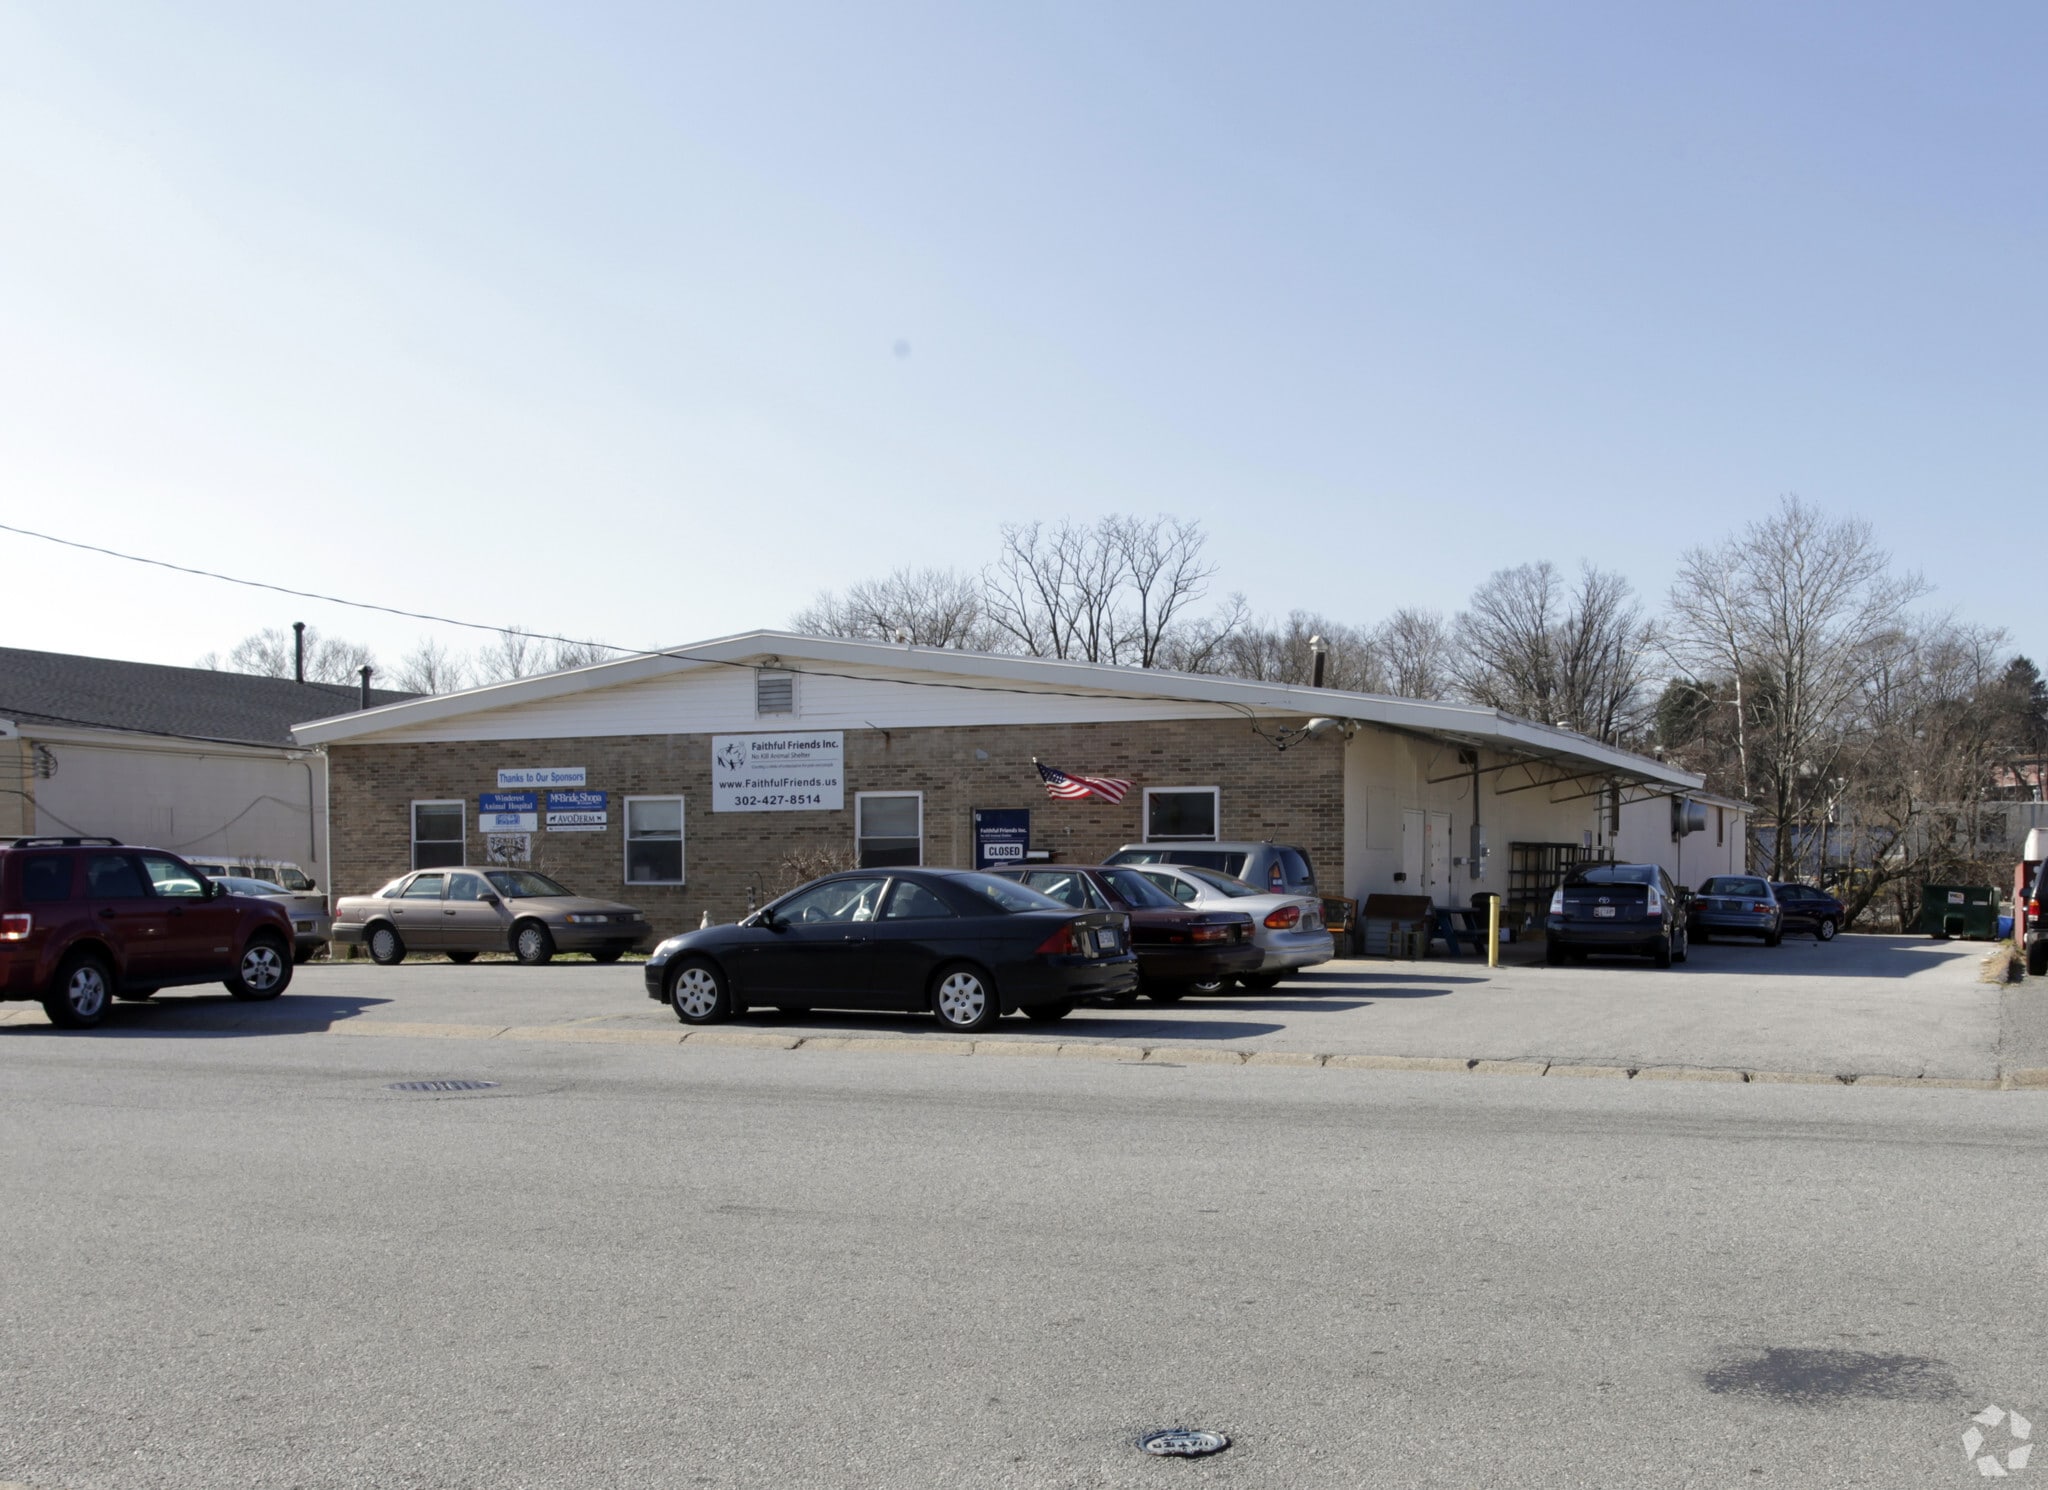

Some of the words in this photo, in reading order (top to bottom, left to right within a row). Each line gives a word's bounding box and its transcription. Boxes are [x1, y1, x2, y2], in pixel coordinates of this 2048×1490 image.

[752, 741, 786, 751] Faithful
[788, 740, 821, 750] Friends
[822, 739, 839, 749] Inc.
[500, 773, 524, 783] Thanks
[527, 773, 534, 782] to
[536, 773, 548, 782] Our
[551, 772, 584, 783] Sponsors
[719, 778, 837, 789] www.FaithfulFriends.us
[735, 795, 821, 806] 302-427-8514
[508, 802, 533, 811] Hospital
[989, 846, 1020, 856] CLOSED
